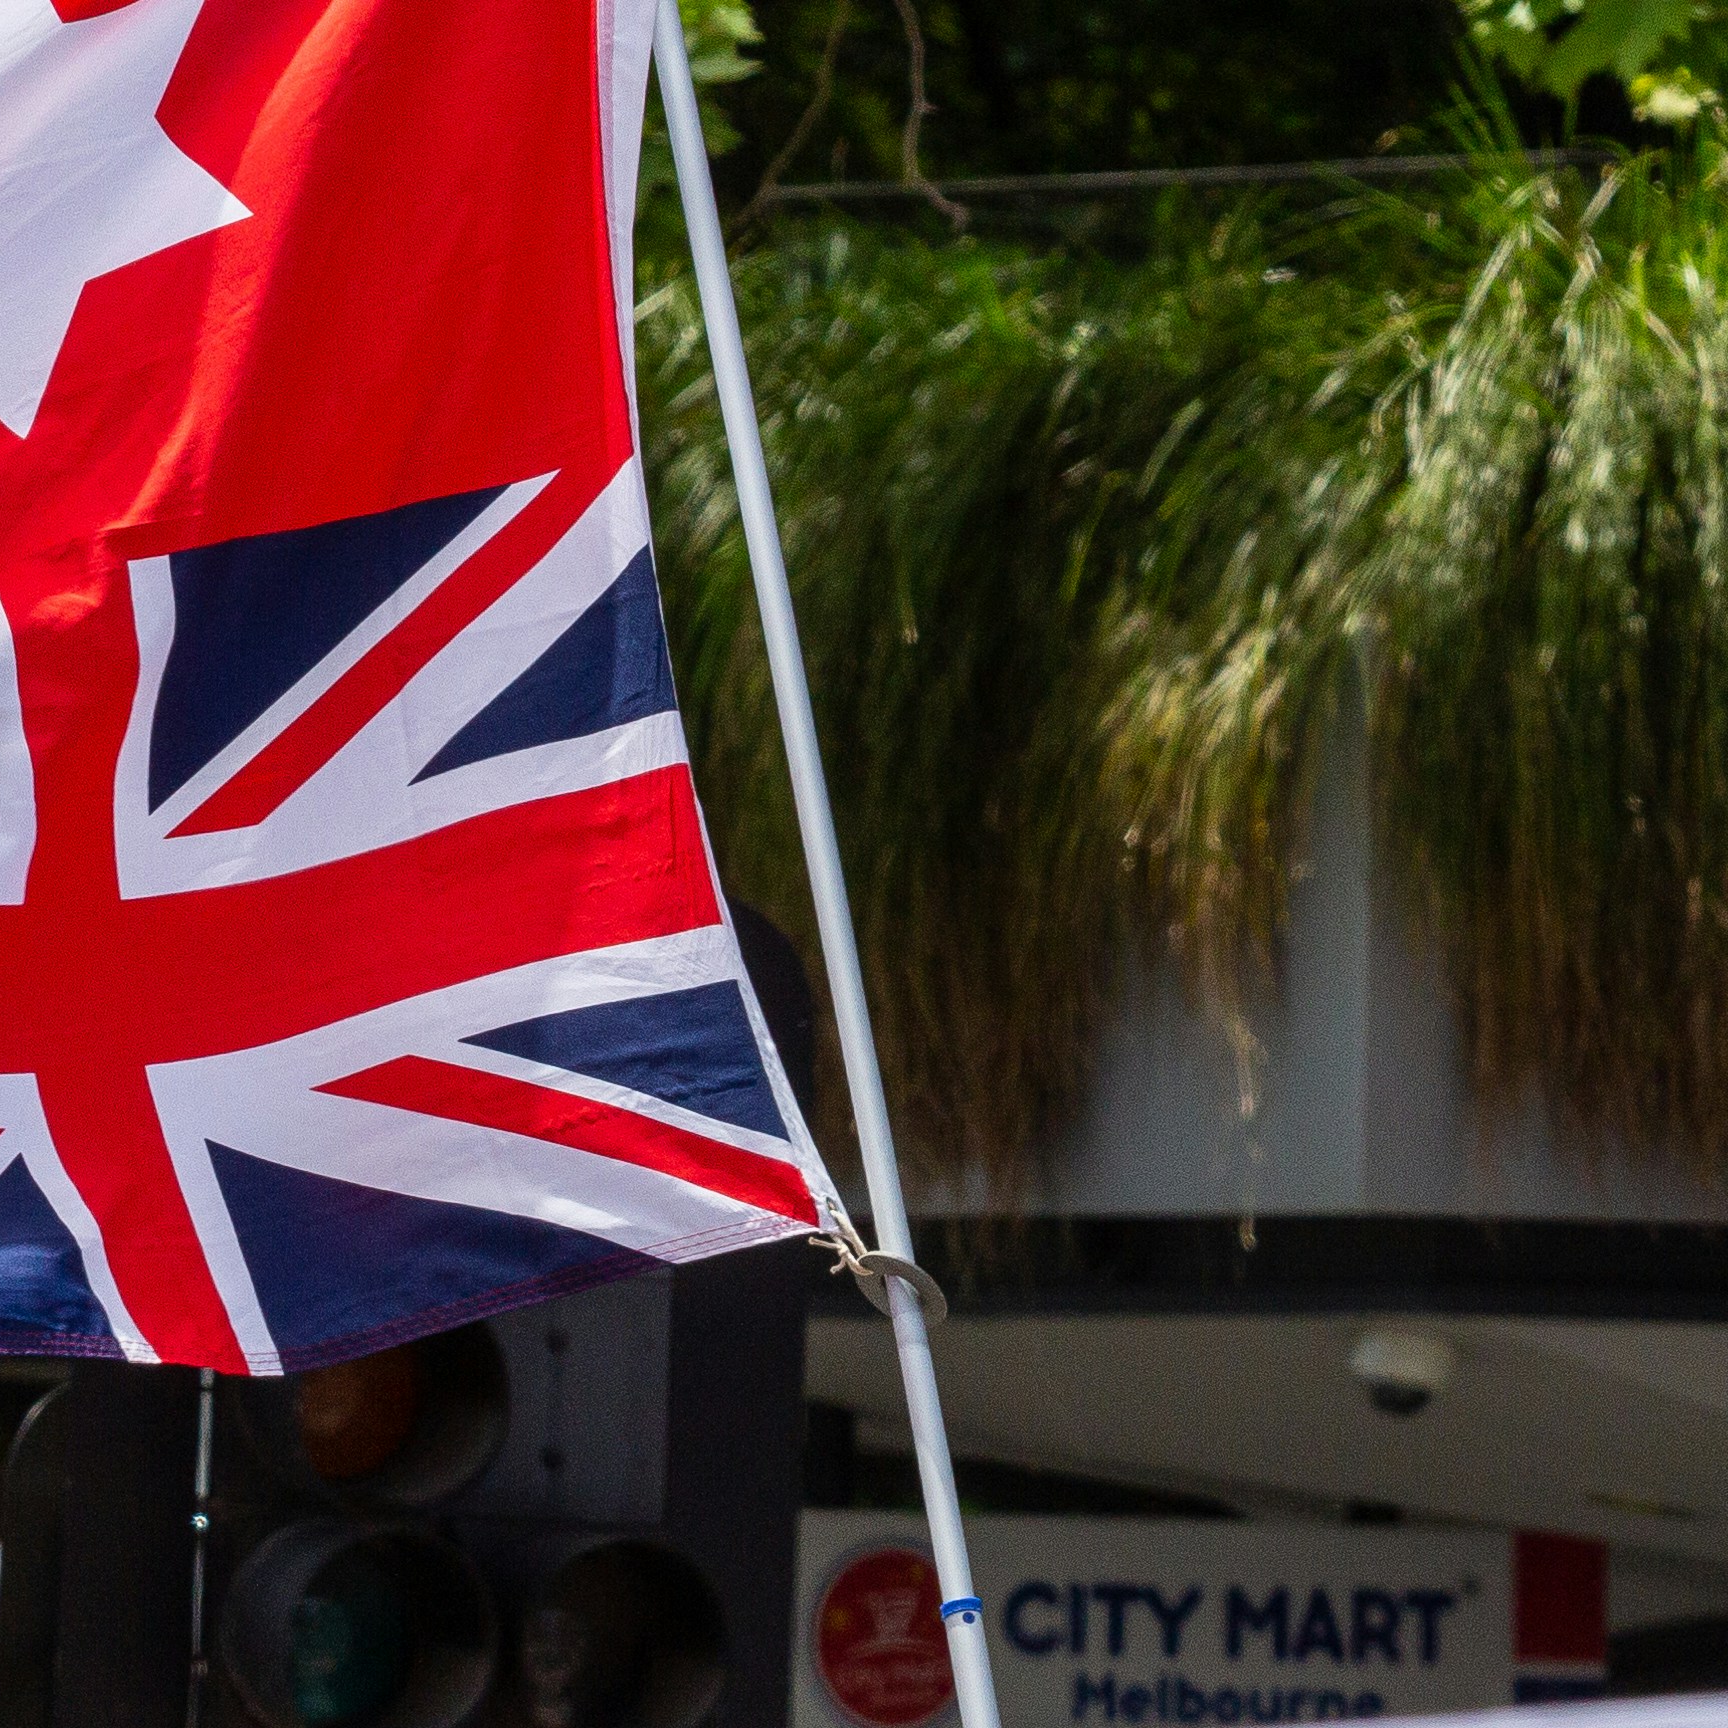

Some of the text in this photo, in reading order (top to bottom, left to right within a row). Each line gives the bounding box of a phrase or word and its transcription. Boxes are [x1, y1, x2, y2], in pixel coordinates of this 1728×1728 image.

[1003, 1579, 1456, 1665] CITY MART
[1073, 1675, 1386, 1726] Melbourne
